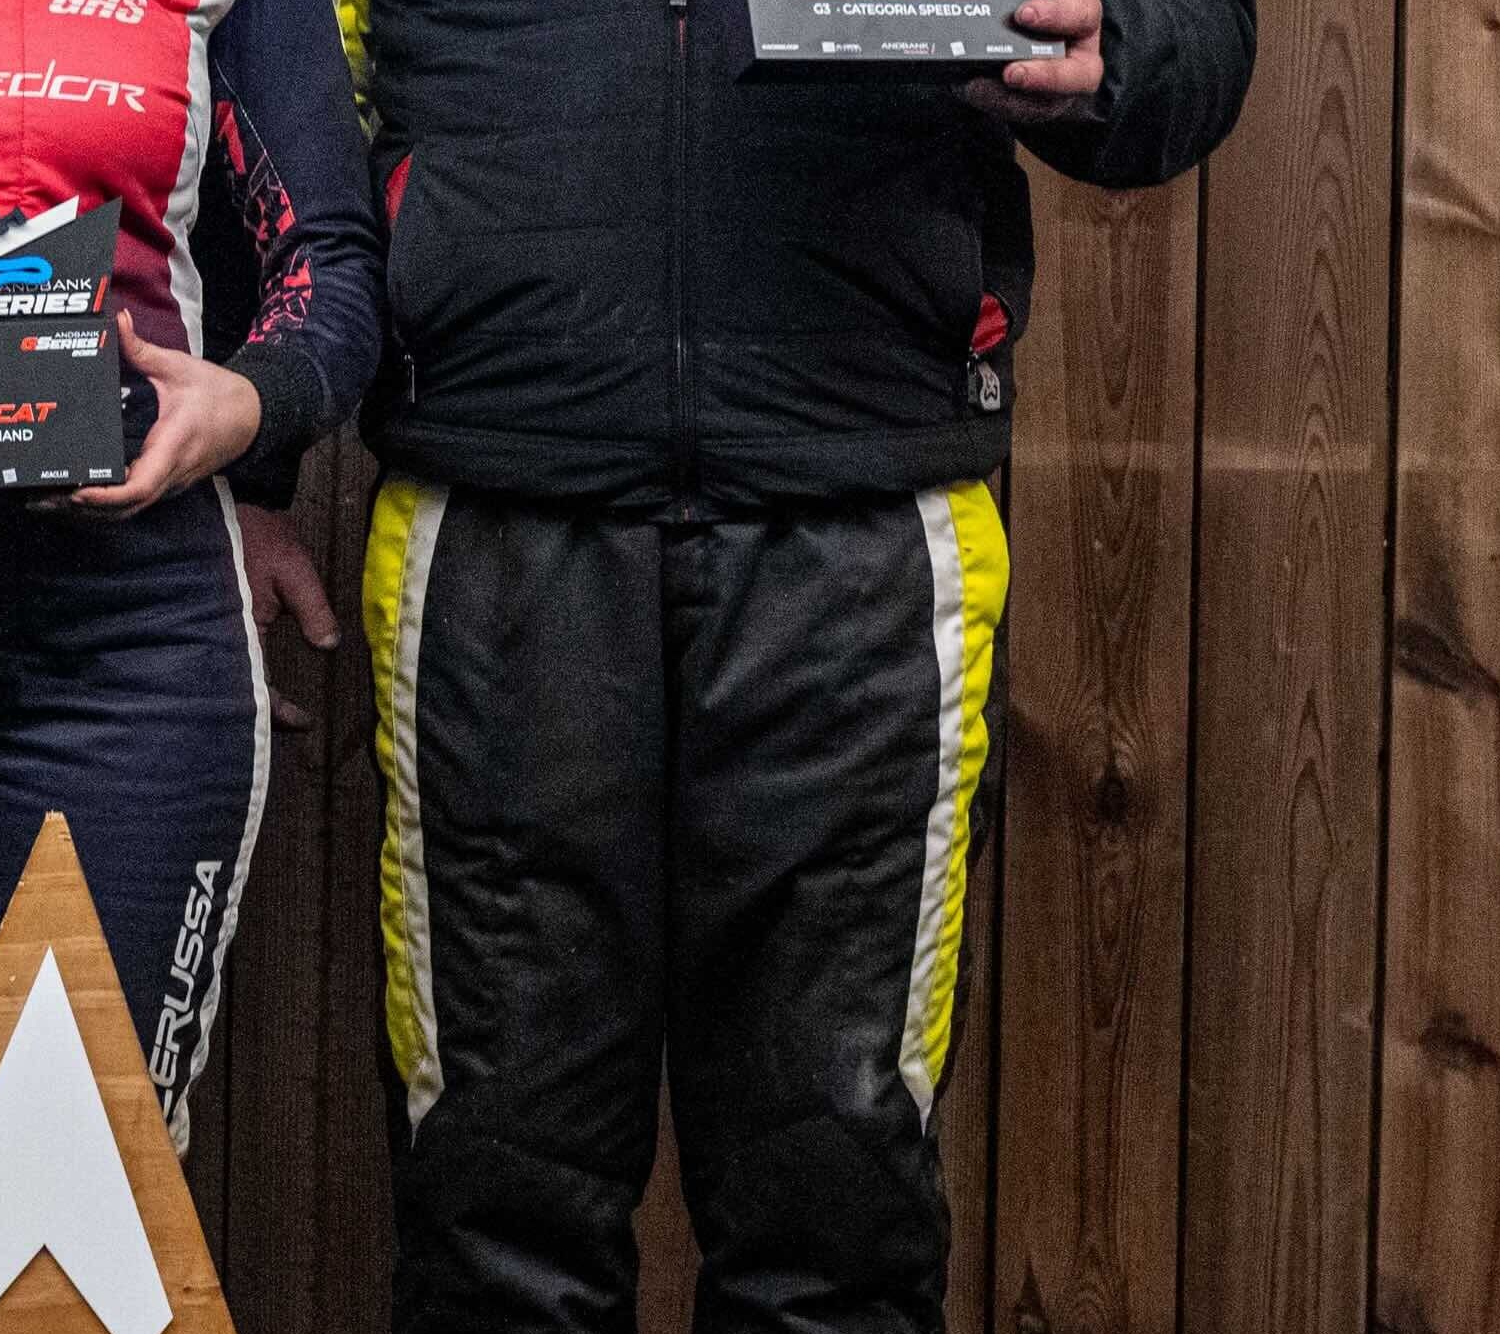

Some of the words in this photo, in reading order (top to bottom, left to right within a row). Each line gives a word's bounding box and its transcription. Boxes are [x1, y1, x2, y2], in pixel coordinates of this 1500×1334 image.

[813, 3, 832, 17] G3
[842, 3, 917, 17] CATEGORIA
[919, 3, 961, 17] SPEED
[964, 3, 992, 17] CAR
[54, 330, 99, 339] ANDBANK
[20, 335, 99, 352] GSERIES
[150, 860, 222, 1118] ERUSSA
